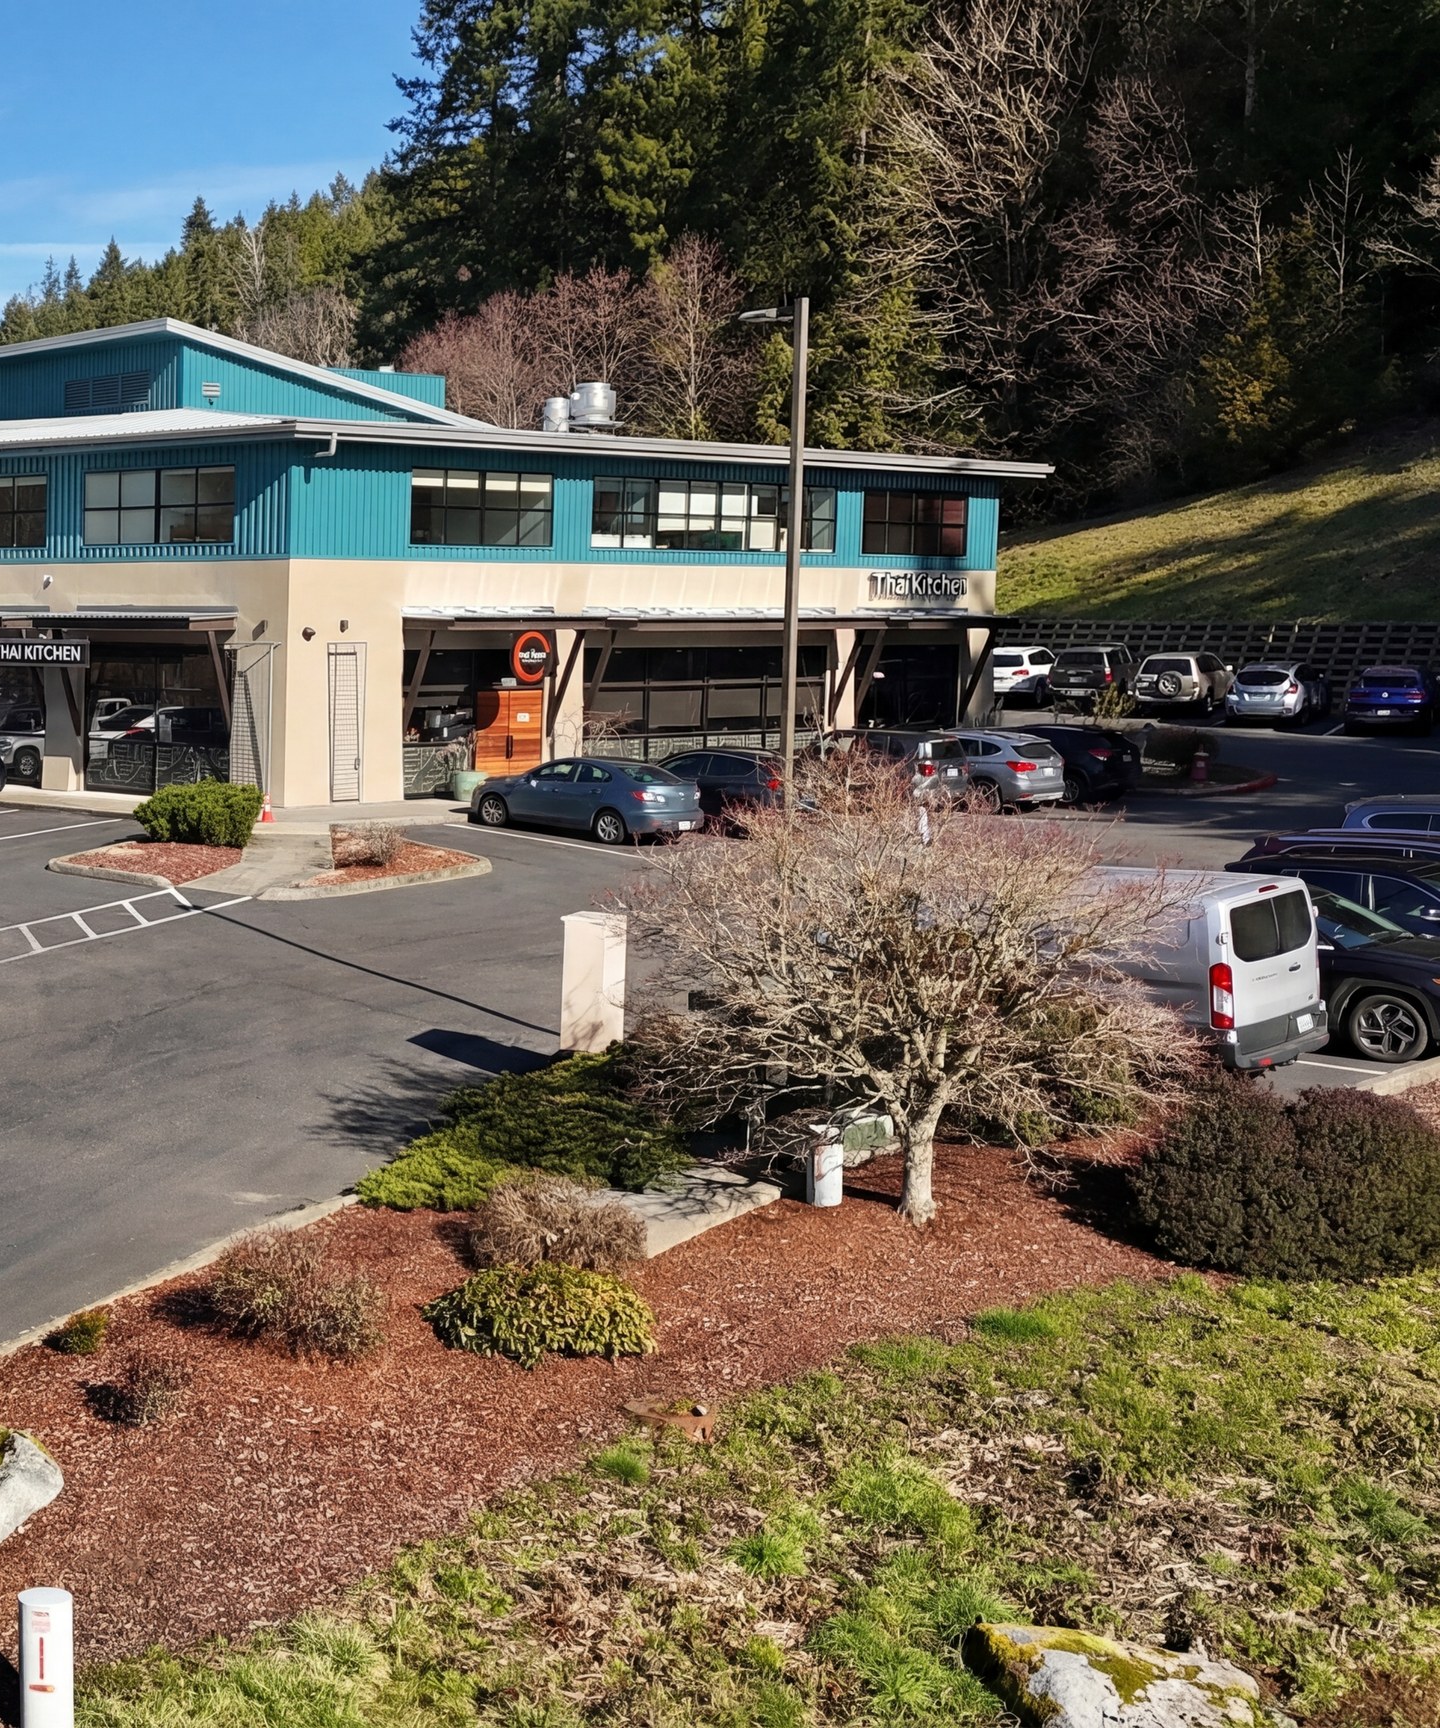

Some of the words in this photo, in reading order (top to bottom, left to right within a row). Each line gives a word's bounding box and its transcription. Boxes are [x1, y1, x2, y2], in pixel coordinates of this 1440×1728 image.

[872, 572, 909, 595] Thai
[912, 573, 967, 595] Kitchen
[25, 645, 81, 661] KITCHEN
